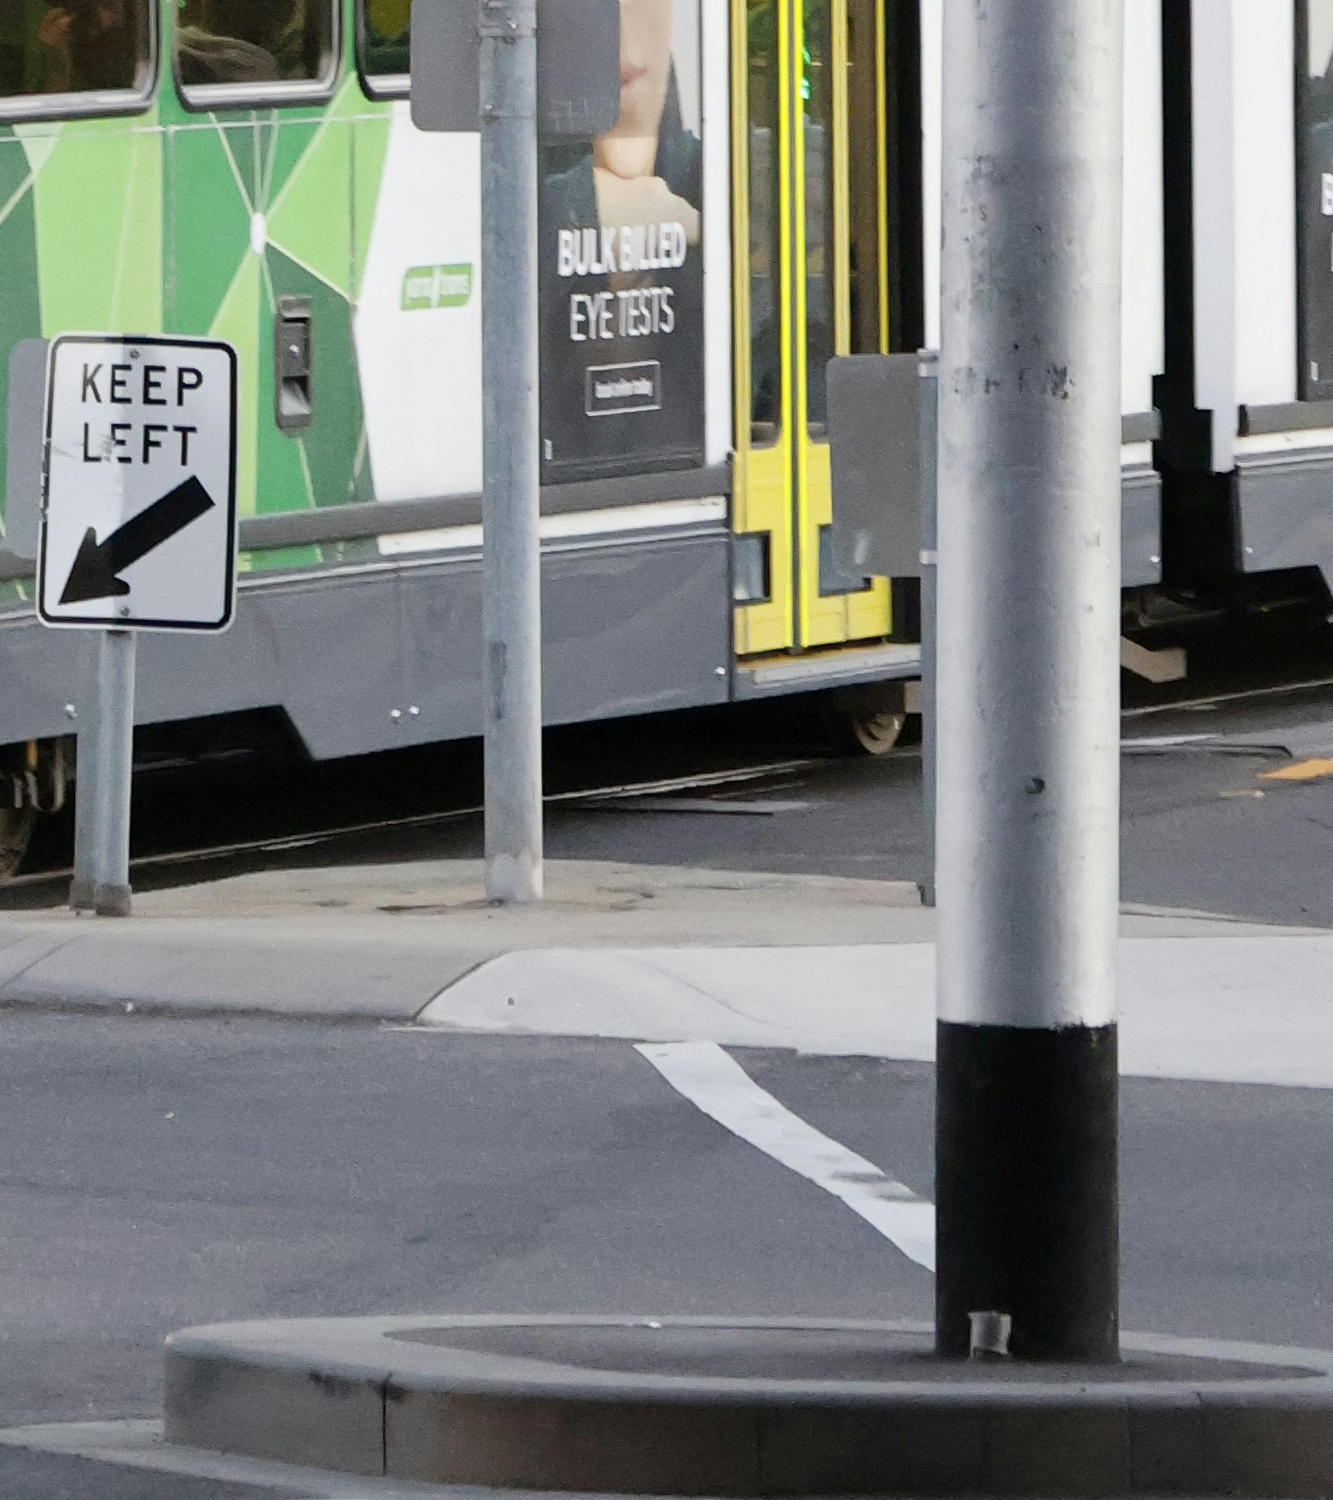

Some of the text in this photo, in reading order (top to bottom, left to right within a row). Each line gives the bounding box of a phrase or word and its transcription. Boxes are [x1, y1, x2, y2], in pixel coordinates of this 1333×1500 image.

[557, 221, 687, 277] BULK BILLED
[569, 285, 676, 342] EYE TESTS
[81, 362, 204, 407] KEEP
[81, 421, 198, 467] LEFT
